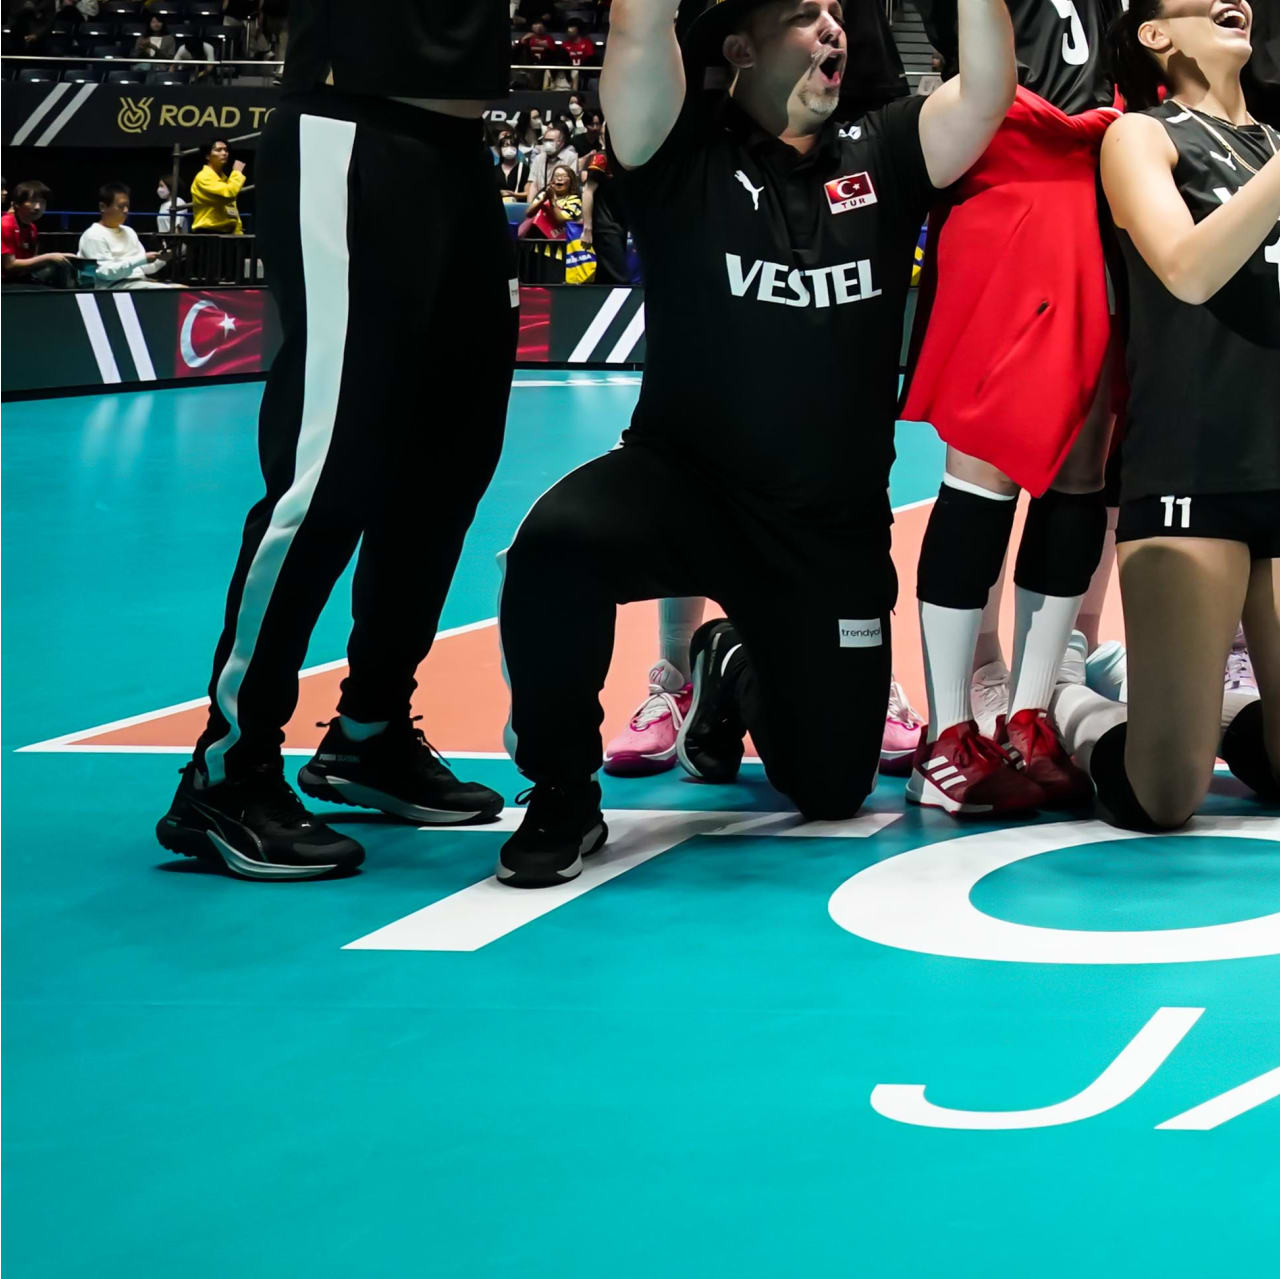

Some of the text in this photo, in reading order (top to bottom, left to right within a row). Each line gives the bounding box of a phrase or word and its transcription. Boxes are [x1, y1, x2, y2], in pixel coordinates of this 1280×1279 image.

[158, 103, 242, 129] ROAD
[841, 197, 866, 209] TUR
[725, 252, 883, 309] VESTEL
[1160, 495, 1192, 529] 11
